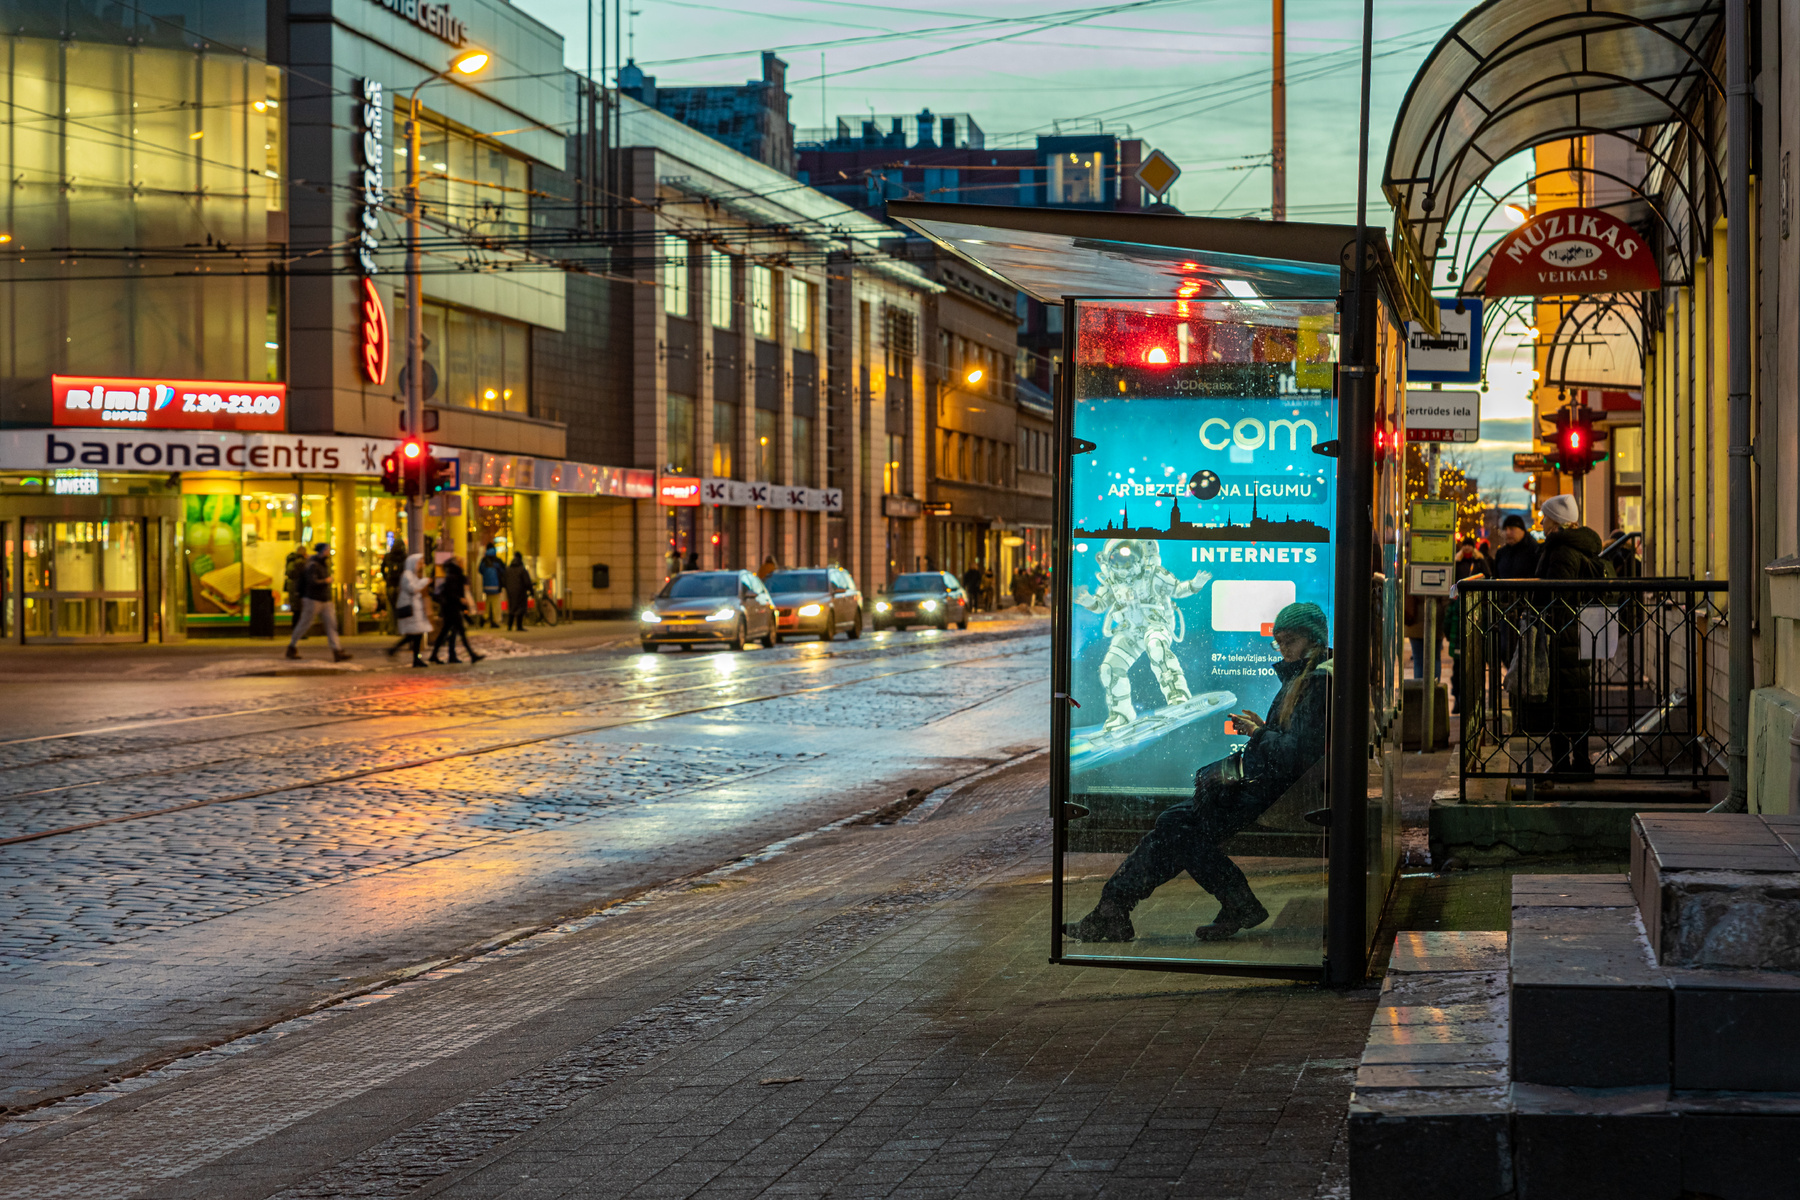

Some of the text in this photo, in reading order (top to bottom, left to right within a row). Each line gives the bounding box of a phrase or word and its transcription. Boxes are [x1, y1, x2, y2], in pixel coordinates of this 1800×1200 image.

[1538, 269, 1608, 283] VEIKALS
[1174, 380, 1234, 391] JCDecaux
[182, 393, 281, 414] 7.30-23.00
[102, 410, 148, 421] SUPER
[1453, 407, 1471, 416] iela
[1199, 417, 1318, 451] com
[47, 434, 339, 469] baronacentrs
[1108, 481, 1312, 499] AR BEZTEŅA LĪGUMU
[1192, 547, 1317, 563] INTERNETS
[1211, 653, 1284, 664] 87+ televīzijas kan
[1211, 666, 1277, 676] Ātrums līdz 100
